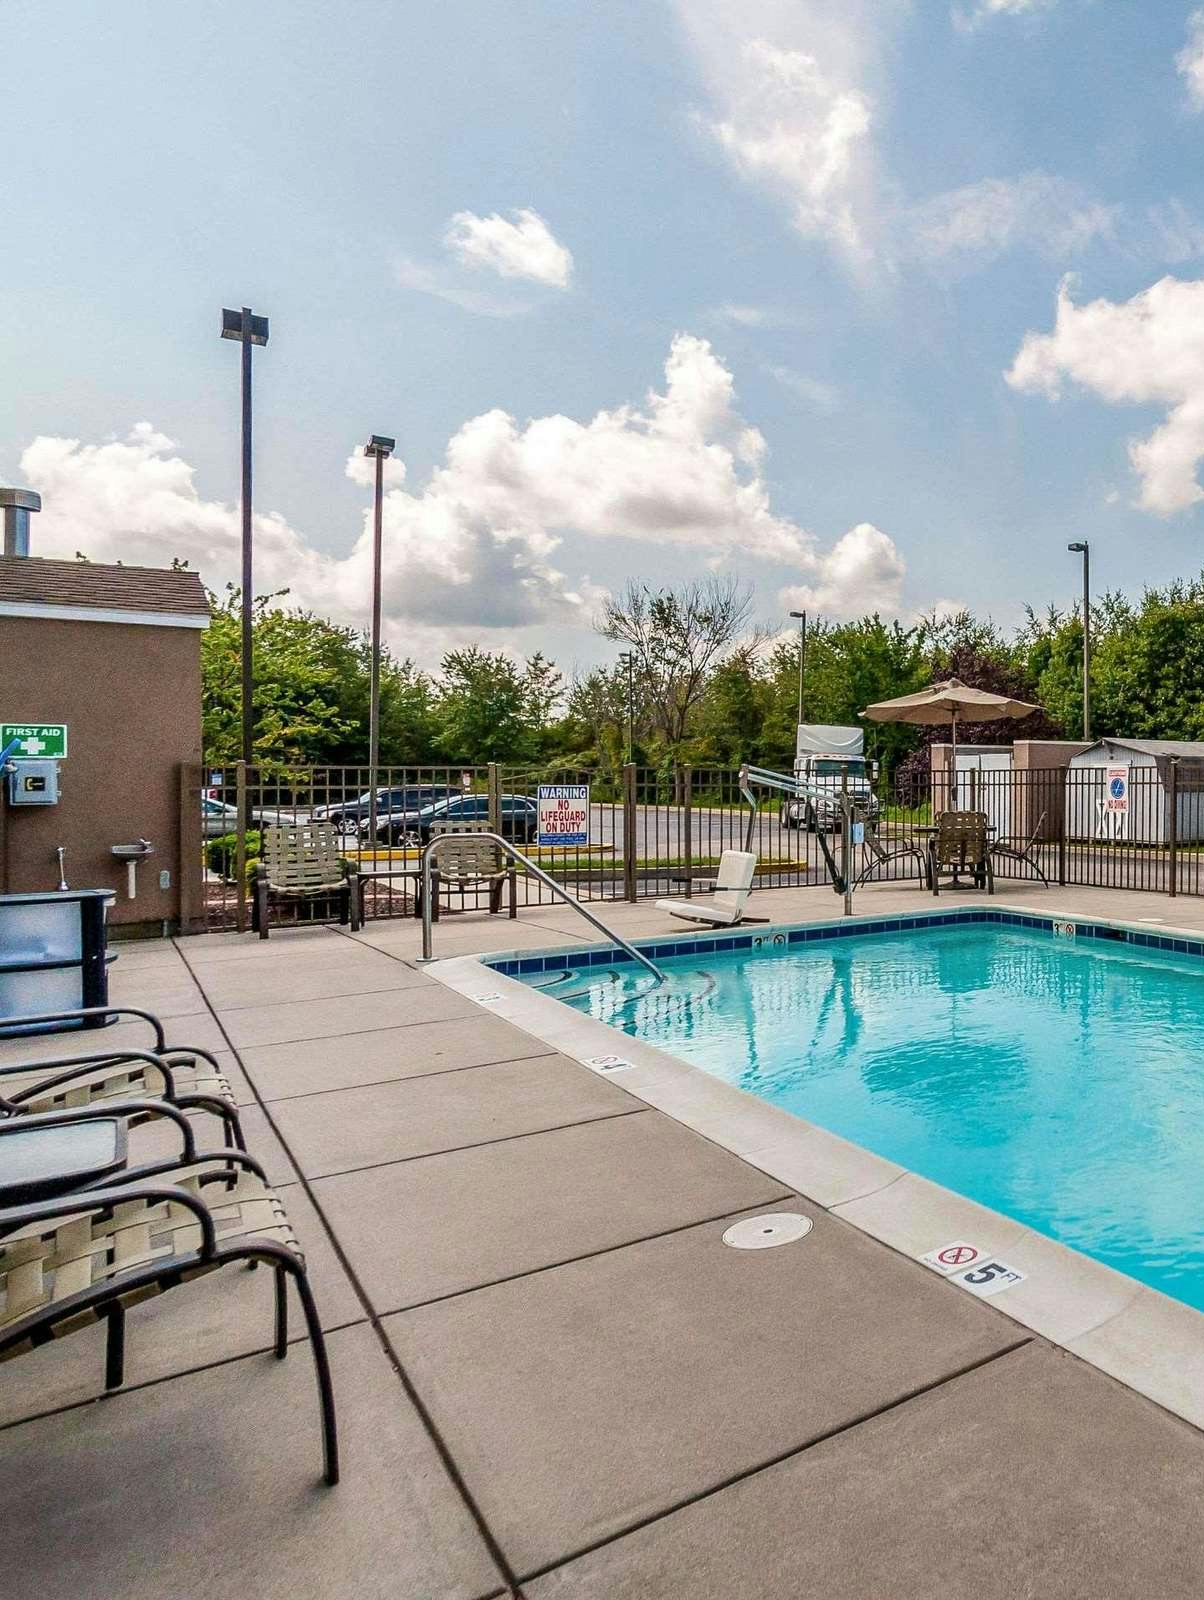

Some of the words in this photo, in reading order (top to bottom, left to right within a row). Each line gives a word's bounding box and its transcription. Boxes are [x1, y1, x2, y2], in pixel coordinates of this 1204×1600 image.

[6, 728, 39, 736] FIRST
[41, 728, 61, 736] AID
[541, 787, 586, 798] WARNING
[558, 800, 570, 810] NO
[541, 811, 586, 821] LIFEGUARD
[546, 822, 557, 832] ON
[560, 822, 581, 832] DUTY
[964, 1263, 1007, 1284] 5
